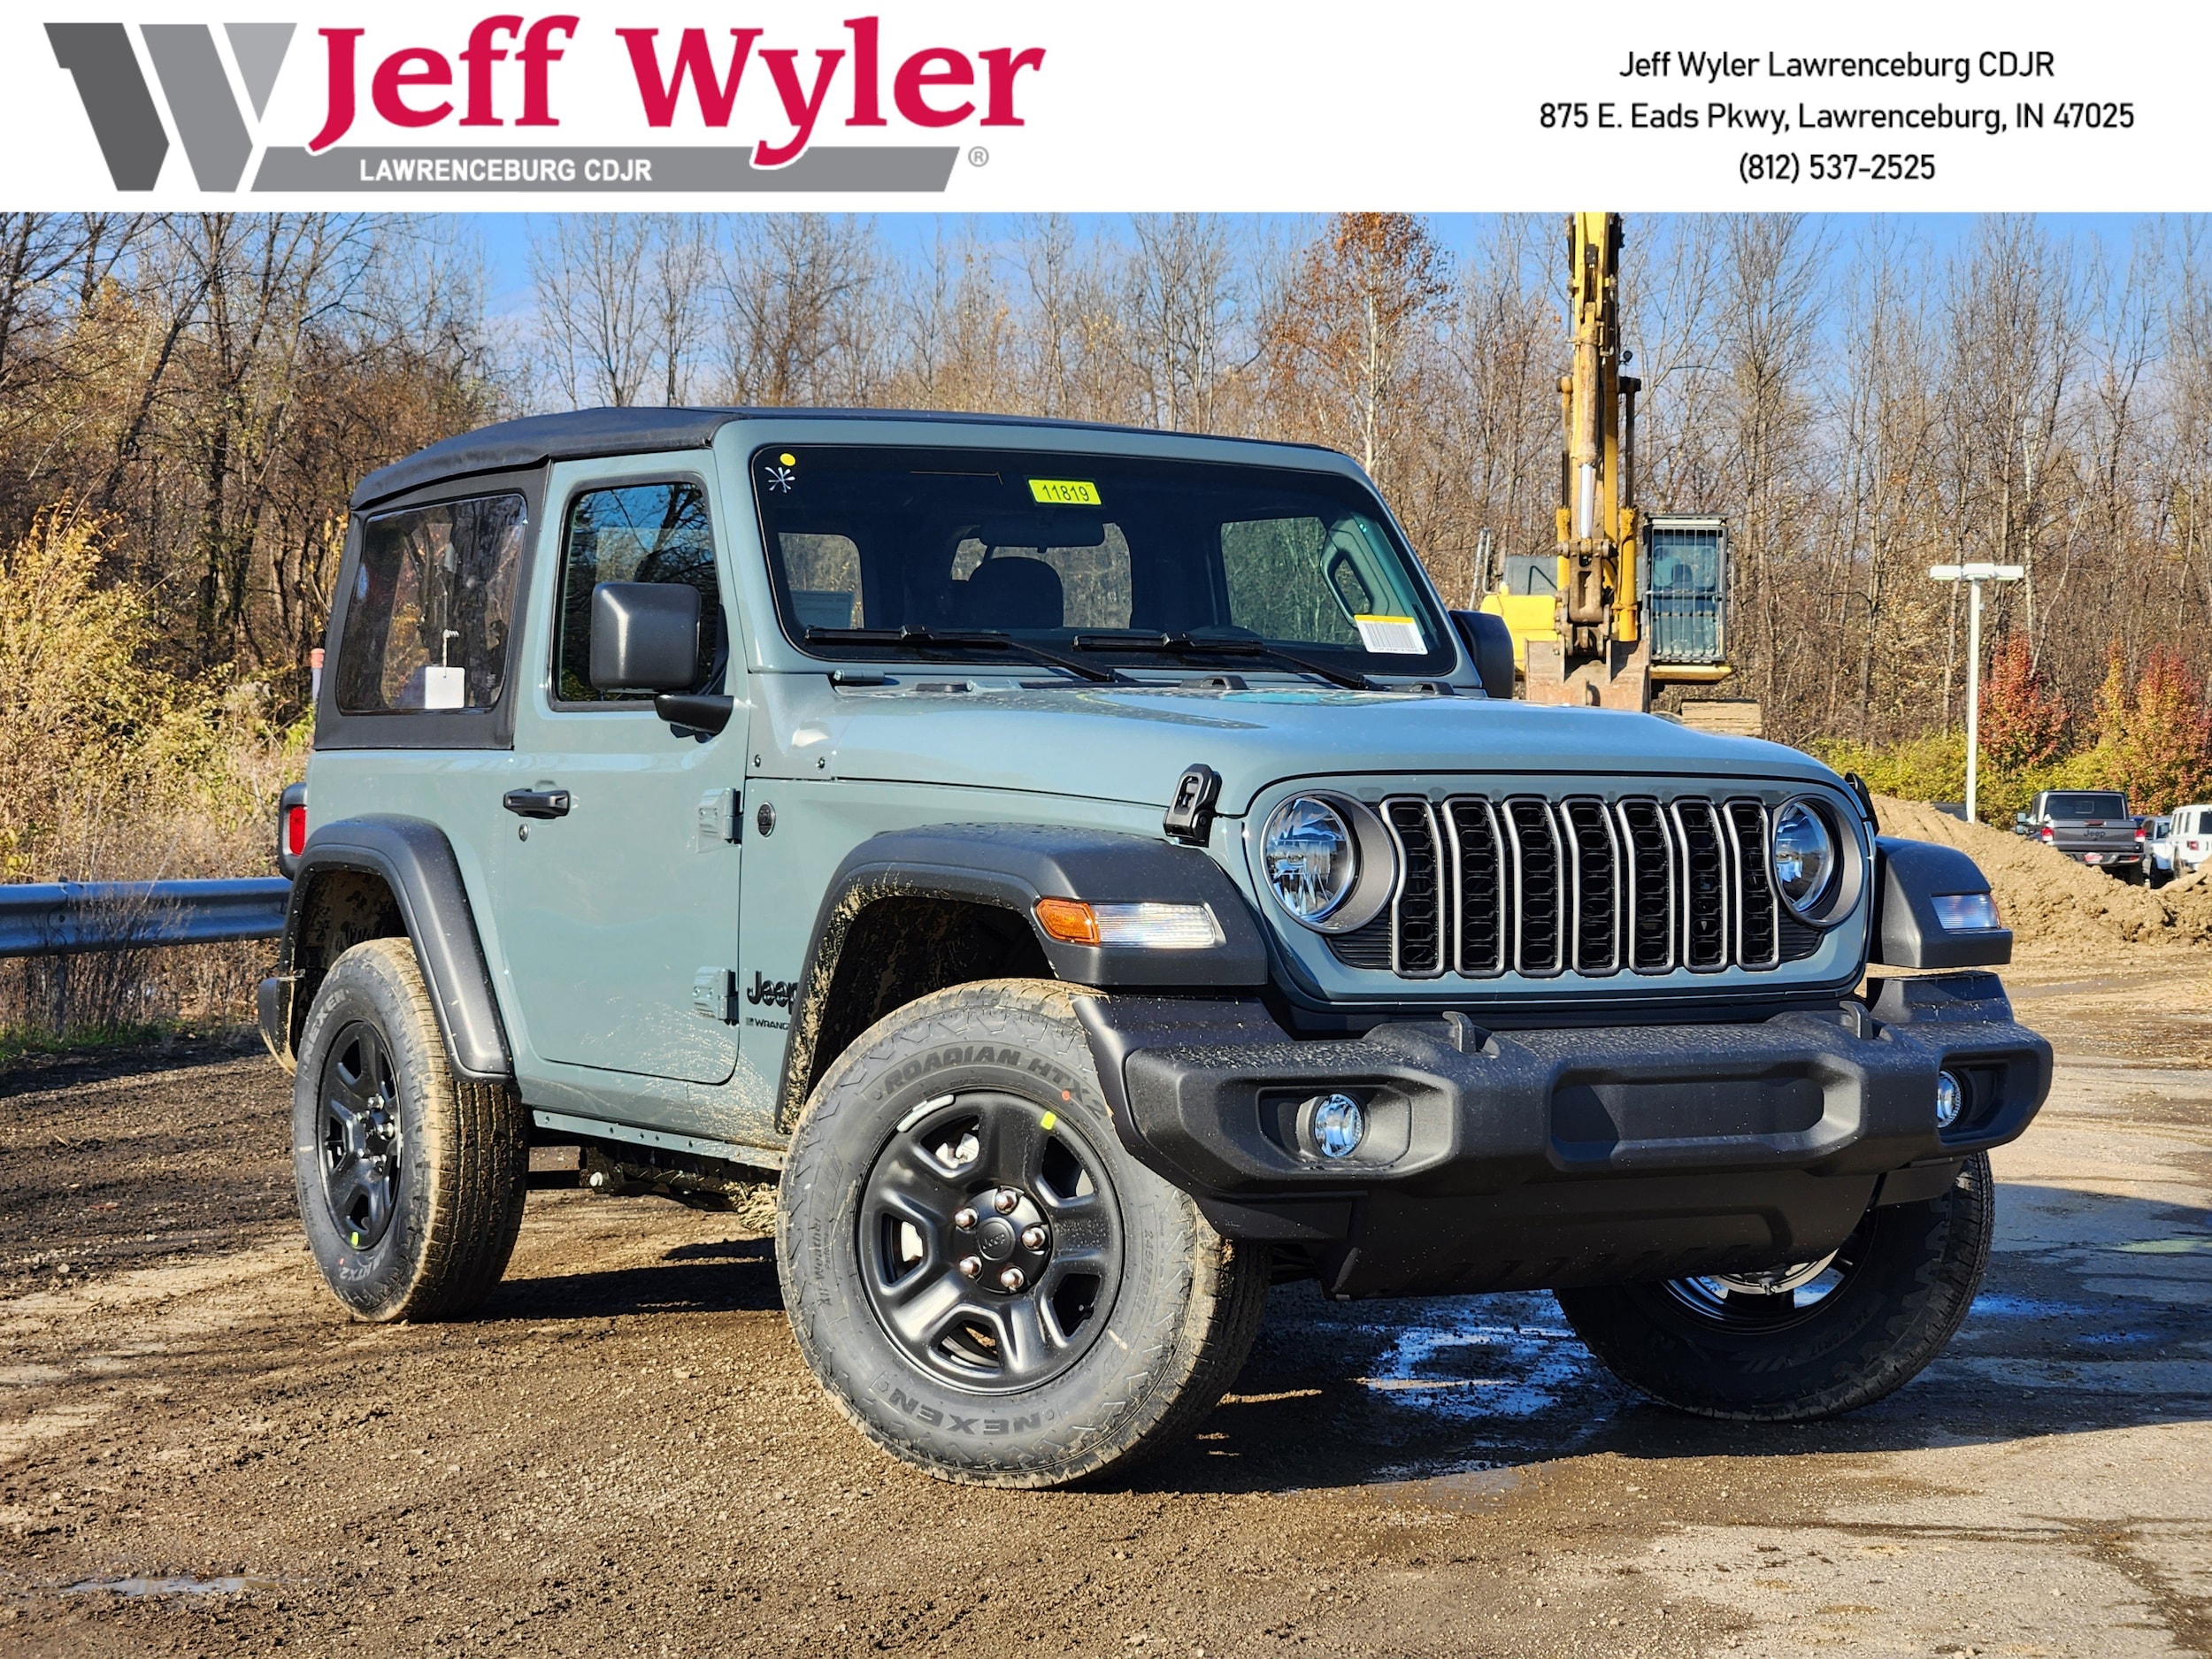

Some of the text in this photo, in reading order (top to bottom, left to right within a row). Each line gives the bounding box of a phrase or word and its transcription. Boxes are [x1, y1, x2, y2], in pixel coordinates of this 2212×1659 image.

[1042, 484, 1090, 502] 11819
[2084, 829, 2106, 839] Jeep
[303, 988, 346, 1065] NEXEN
[754, 1018, 790, 1030] WRANG
[885, 1041, 1021, 1095] ROADIAN
[982, 1233, 1005, 1250] Jeep
[888, 1387, 1042, 1436] NEXEN
